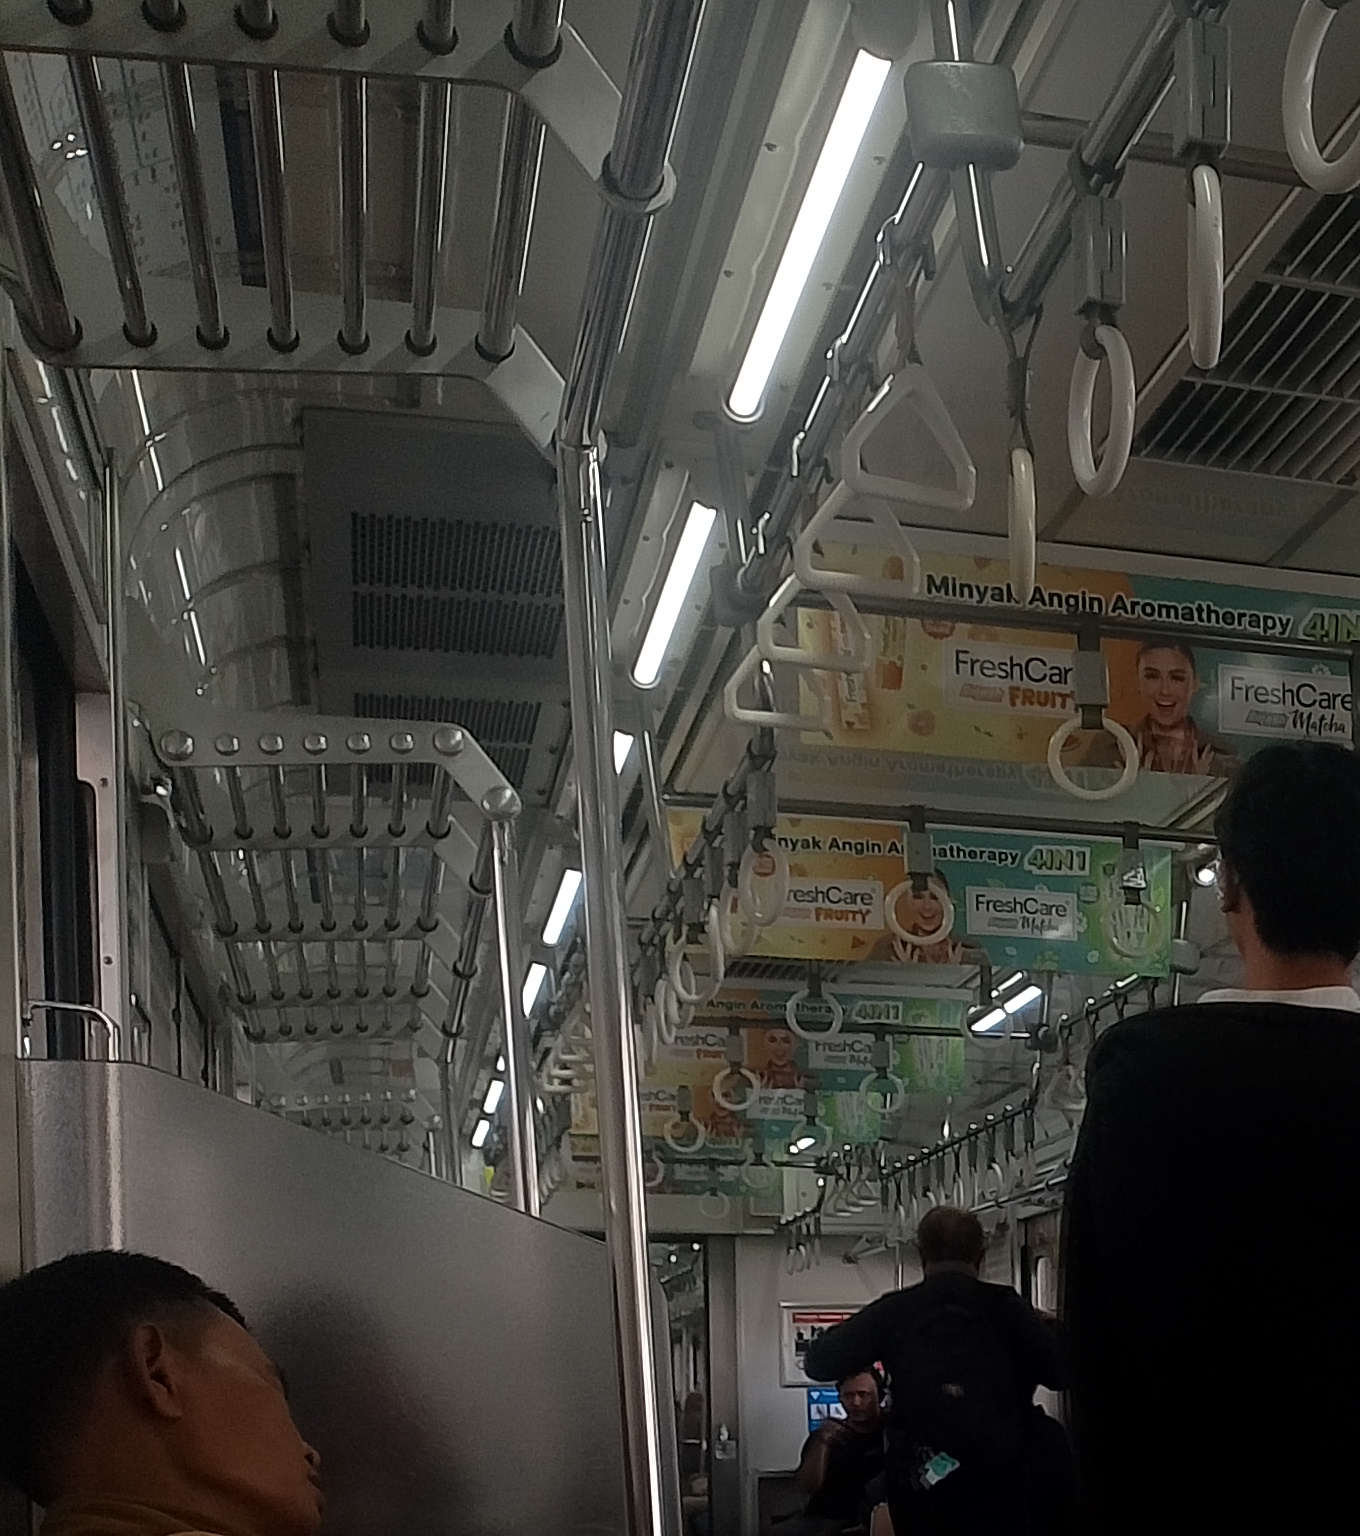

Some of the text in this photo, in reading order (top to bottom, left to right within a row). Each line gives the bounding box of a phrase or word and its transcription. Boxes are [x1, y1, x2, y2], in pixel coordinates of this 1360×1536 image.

[1028, 586, 1103, 614] Angin
[1110, 594, 1291, 635] Aromatherapy
[954, 649, 1074, 685] FreshCar
[1230, 676, 1352, 712] FreshCare
[828, 837, 881, 856] Angin
[1027, 848, 1087, 872] 4IN1
[786, 885, 874, 906] reshCare
[975, 894, 1068, 917] FreshCare
[814, 907, 872, 924] FRUITY
[706, 1000, 747, 1015] Angin
